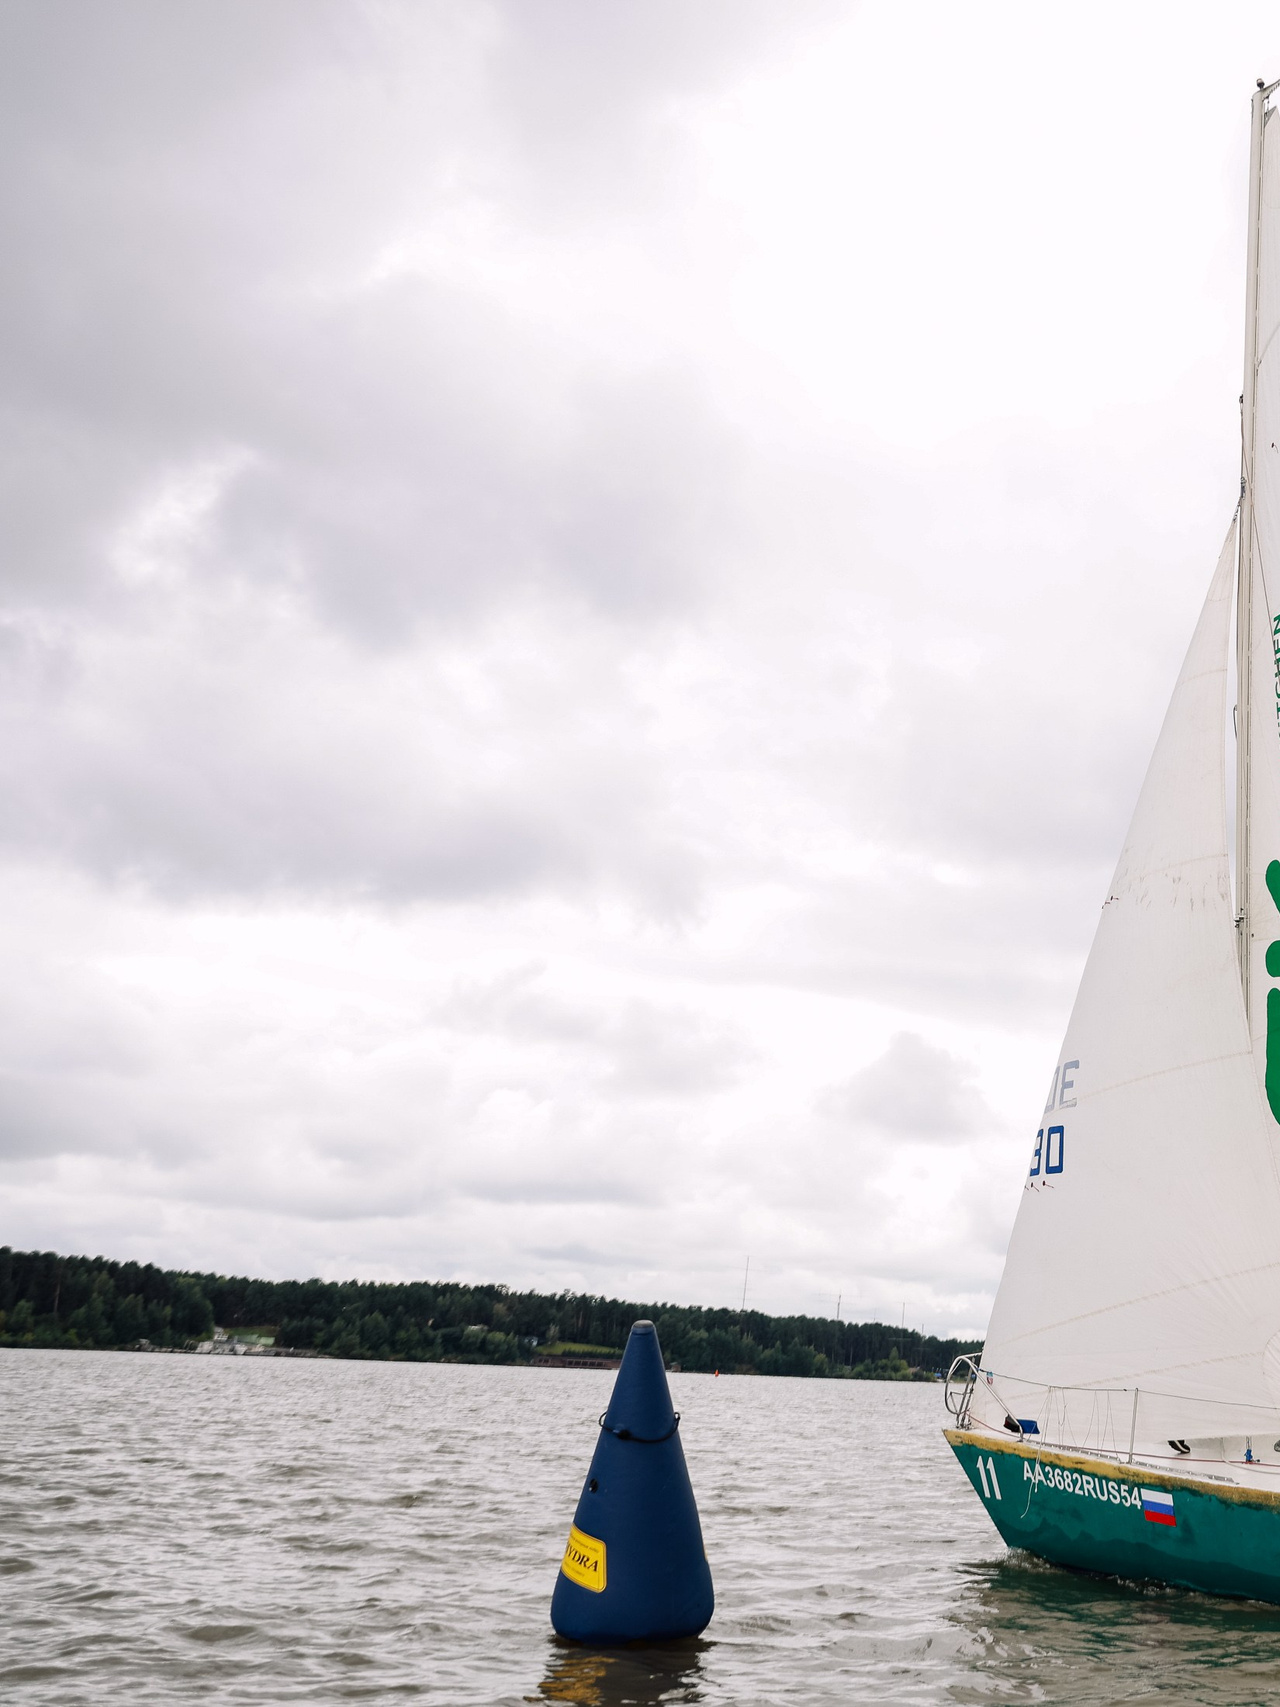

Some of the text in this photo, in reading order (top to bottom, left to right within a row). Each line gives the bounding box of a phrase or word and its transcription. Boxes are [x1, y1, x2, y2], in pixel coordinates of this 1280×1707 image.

[976, 1455, 1002, 1500] 11
[1023, 1460, 1142, 1510] AA3682RUS54
[567, 1542, 600, 1572] YDRA
